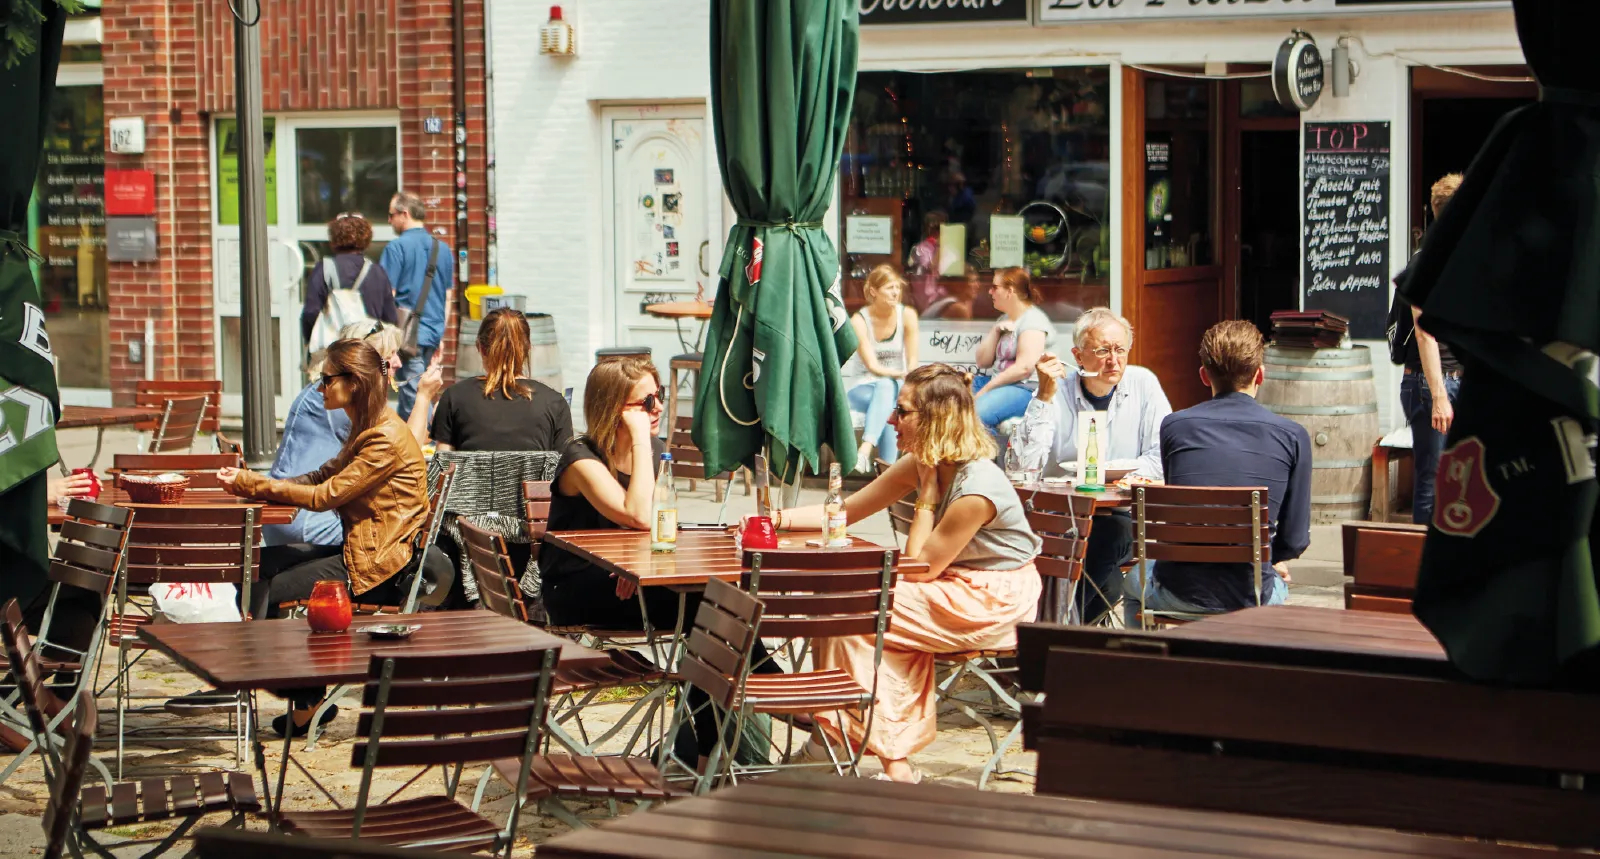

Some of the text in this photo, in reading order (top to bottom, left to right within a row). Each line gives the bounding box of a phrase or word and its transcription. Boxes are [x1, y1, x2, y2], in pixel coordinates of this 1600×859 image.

[426, 117, 440, 132] 162
[113, 128, 131, 145] 162
[1308, 124, 1368, 149] TOP
[76, 173, 91, 185] und
[1360, 178, 1381, 191] mit
[1307, 193, 1348, 210] Tomaten
[1347, 203, 1372, 218] 8,90
[1356, 250, 1382, 266] 10,90
